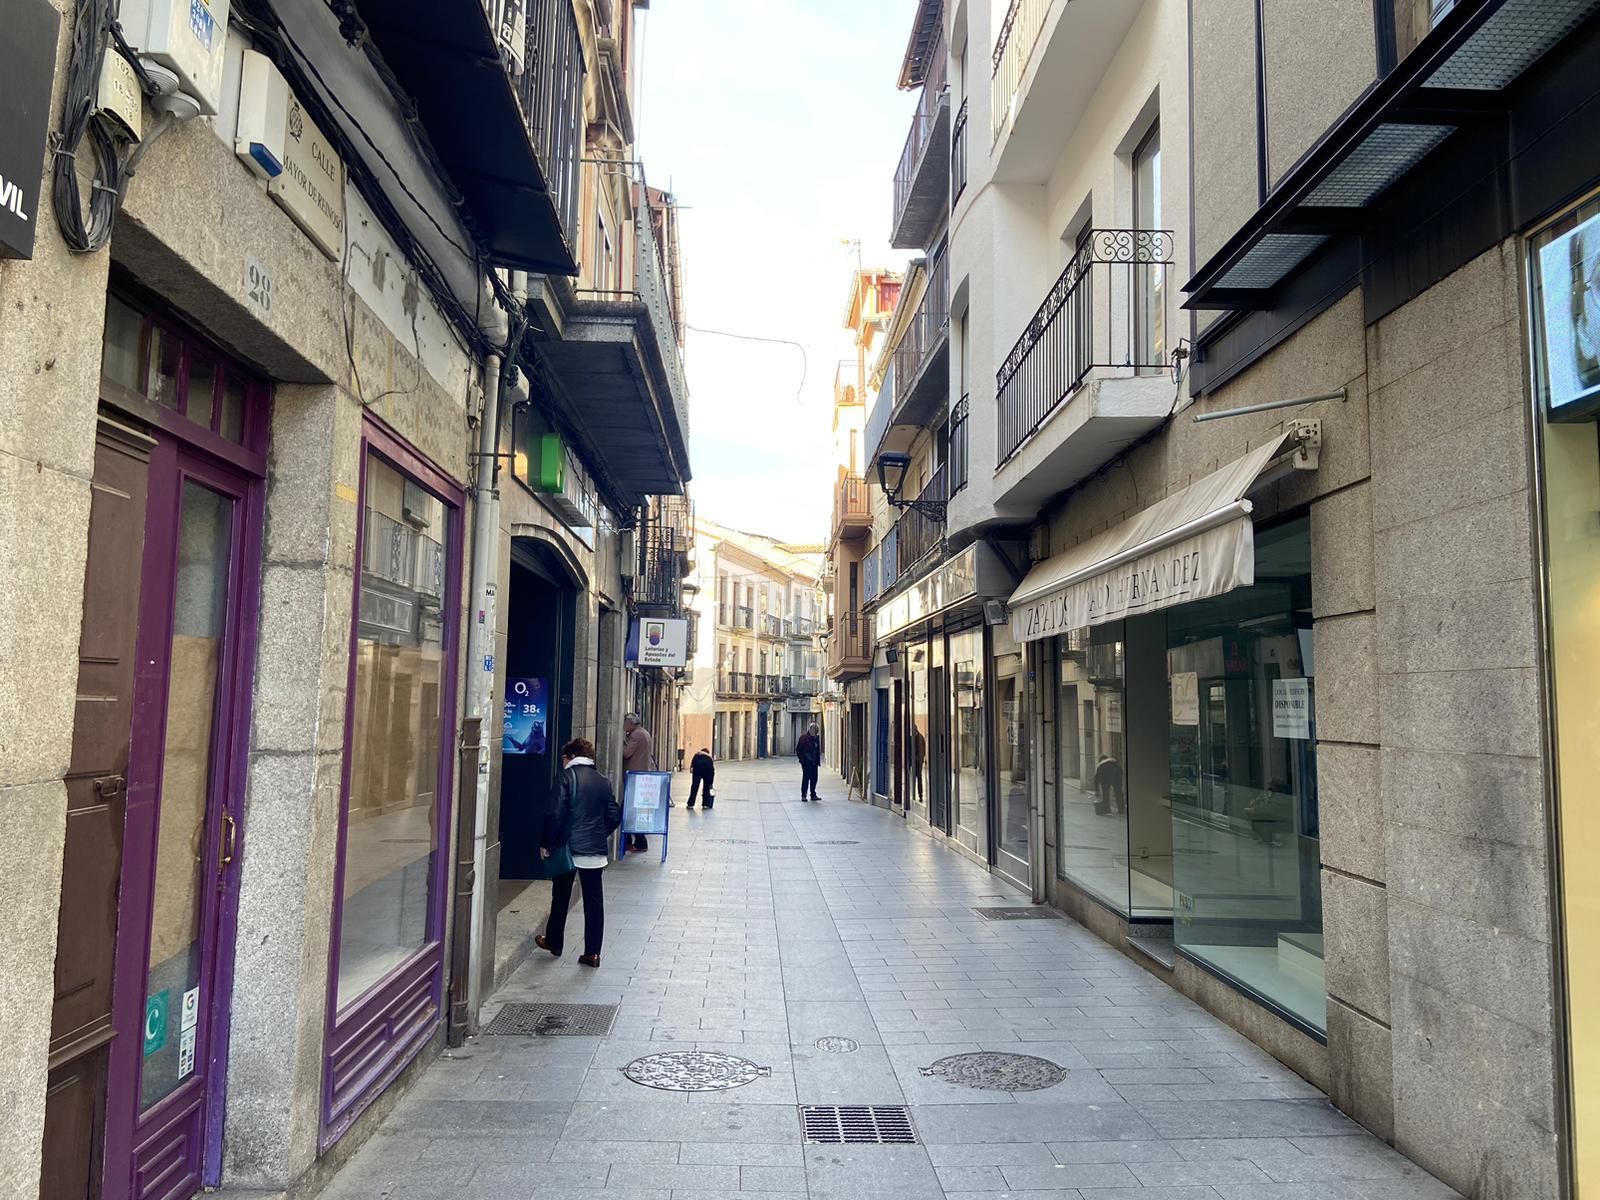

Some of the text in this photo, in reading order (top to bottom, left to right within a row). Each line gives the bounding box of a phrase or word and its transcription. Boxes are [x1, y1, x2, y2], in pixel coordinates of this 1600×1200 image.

[312, 142, 335, 182] CALLE
[308, 182, 318, 204] DE
[317, 192, 343, 233] REINOSO
[248, 265, 271, 311] 28
